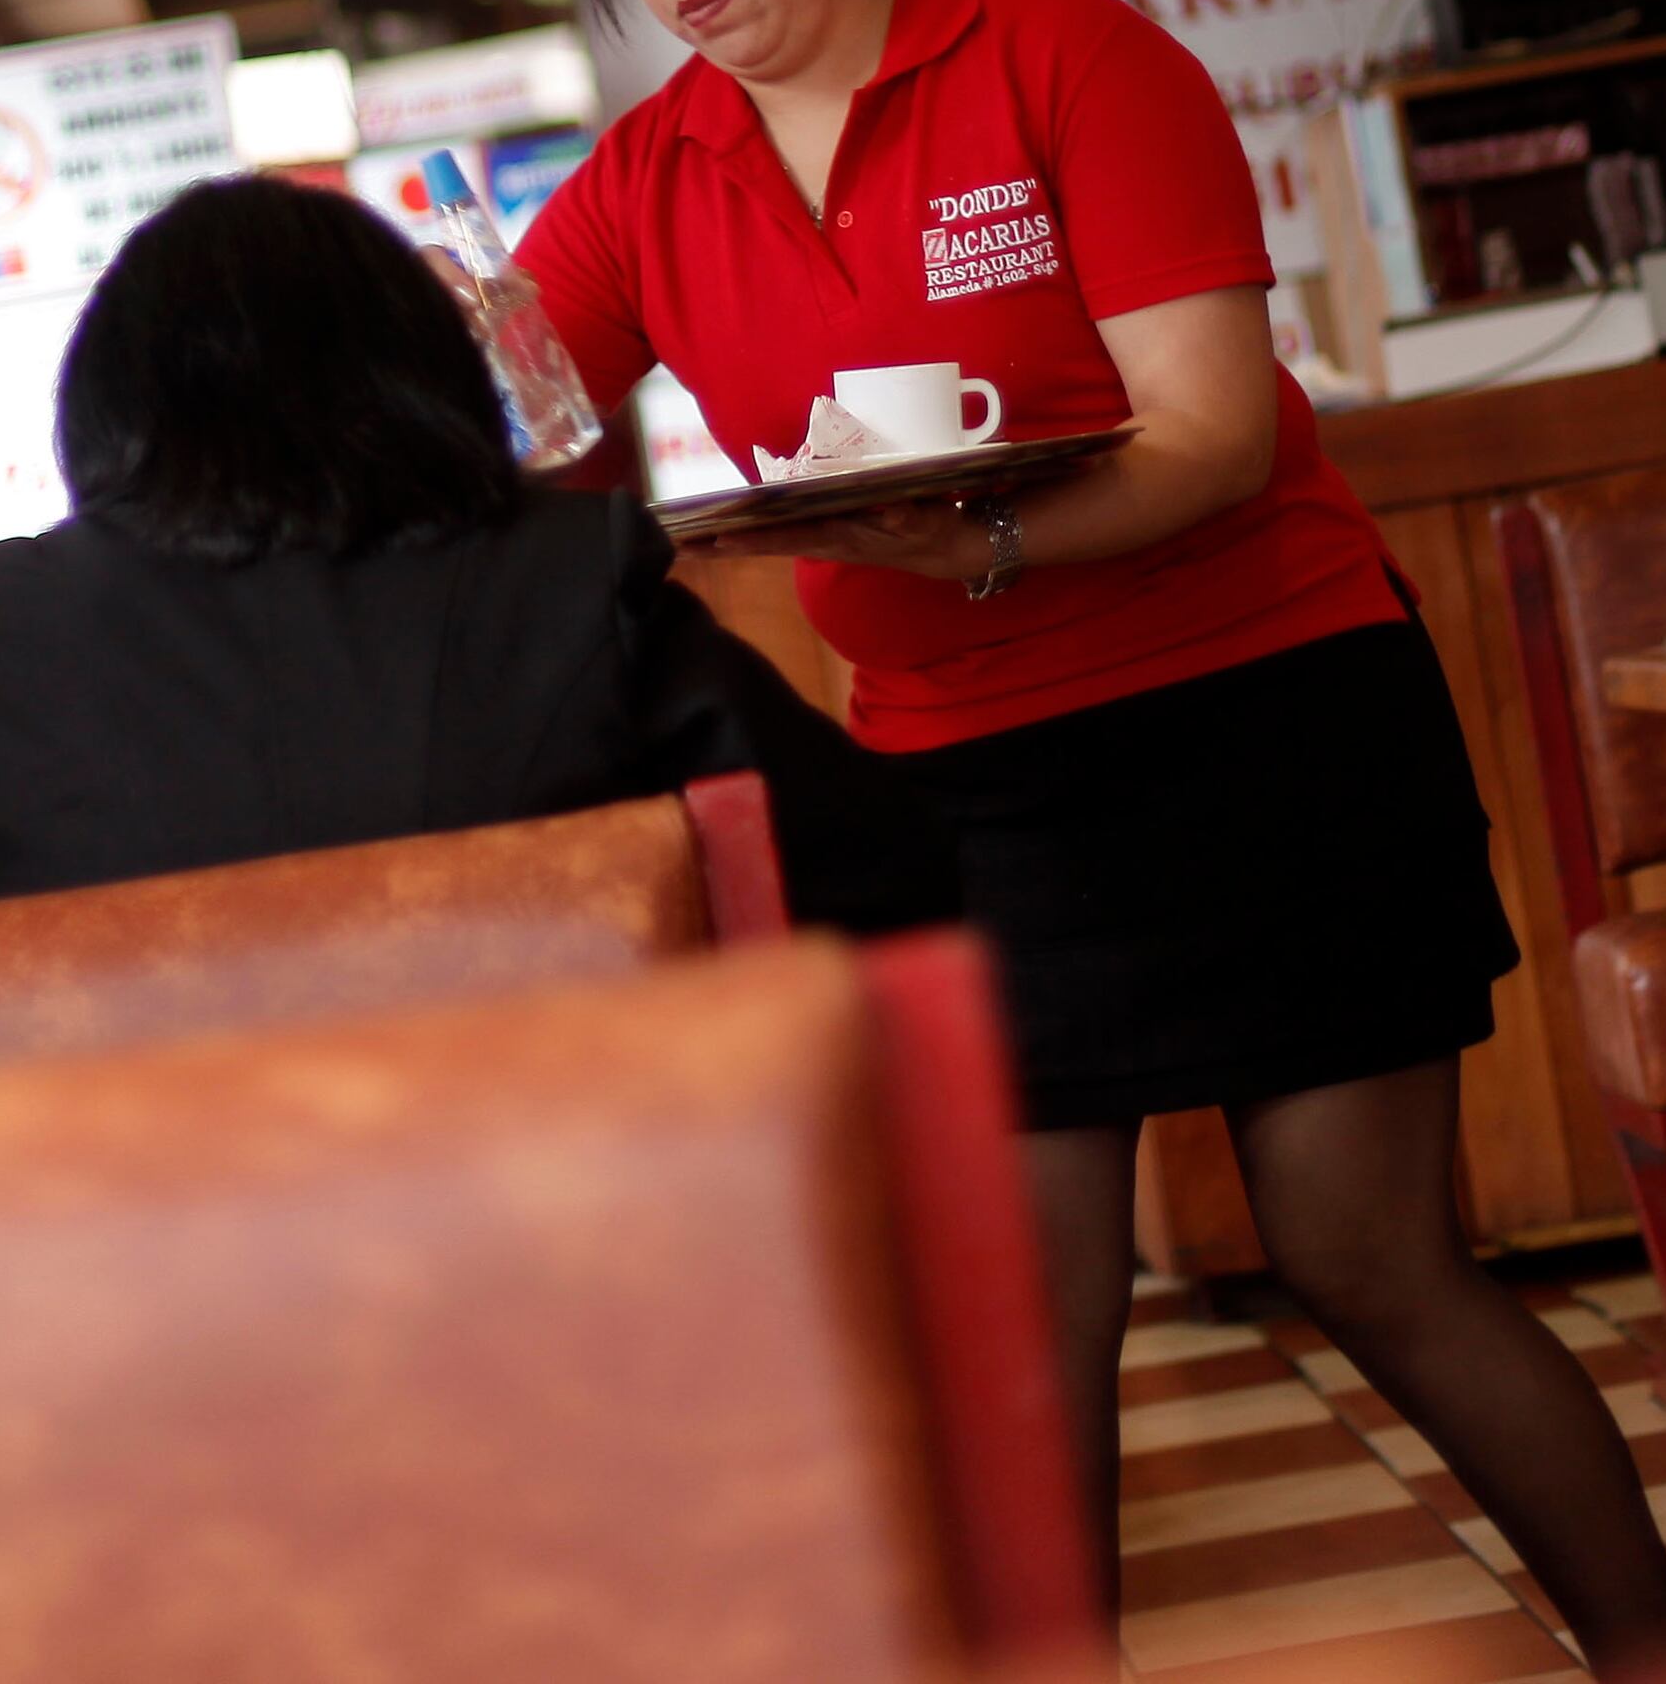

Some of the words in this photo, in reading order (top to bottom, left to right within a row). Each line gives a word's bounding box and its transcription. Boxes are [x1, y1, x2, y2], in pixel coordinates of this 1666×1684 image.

[929, 178, 1037, 222] "DONDE"
[922, 214, 1051, 269] ZACARIAS
[926, 241, 1054, 287] RESTAURANT
[927, 279, 983, 301] Alameda
